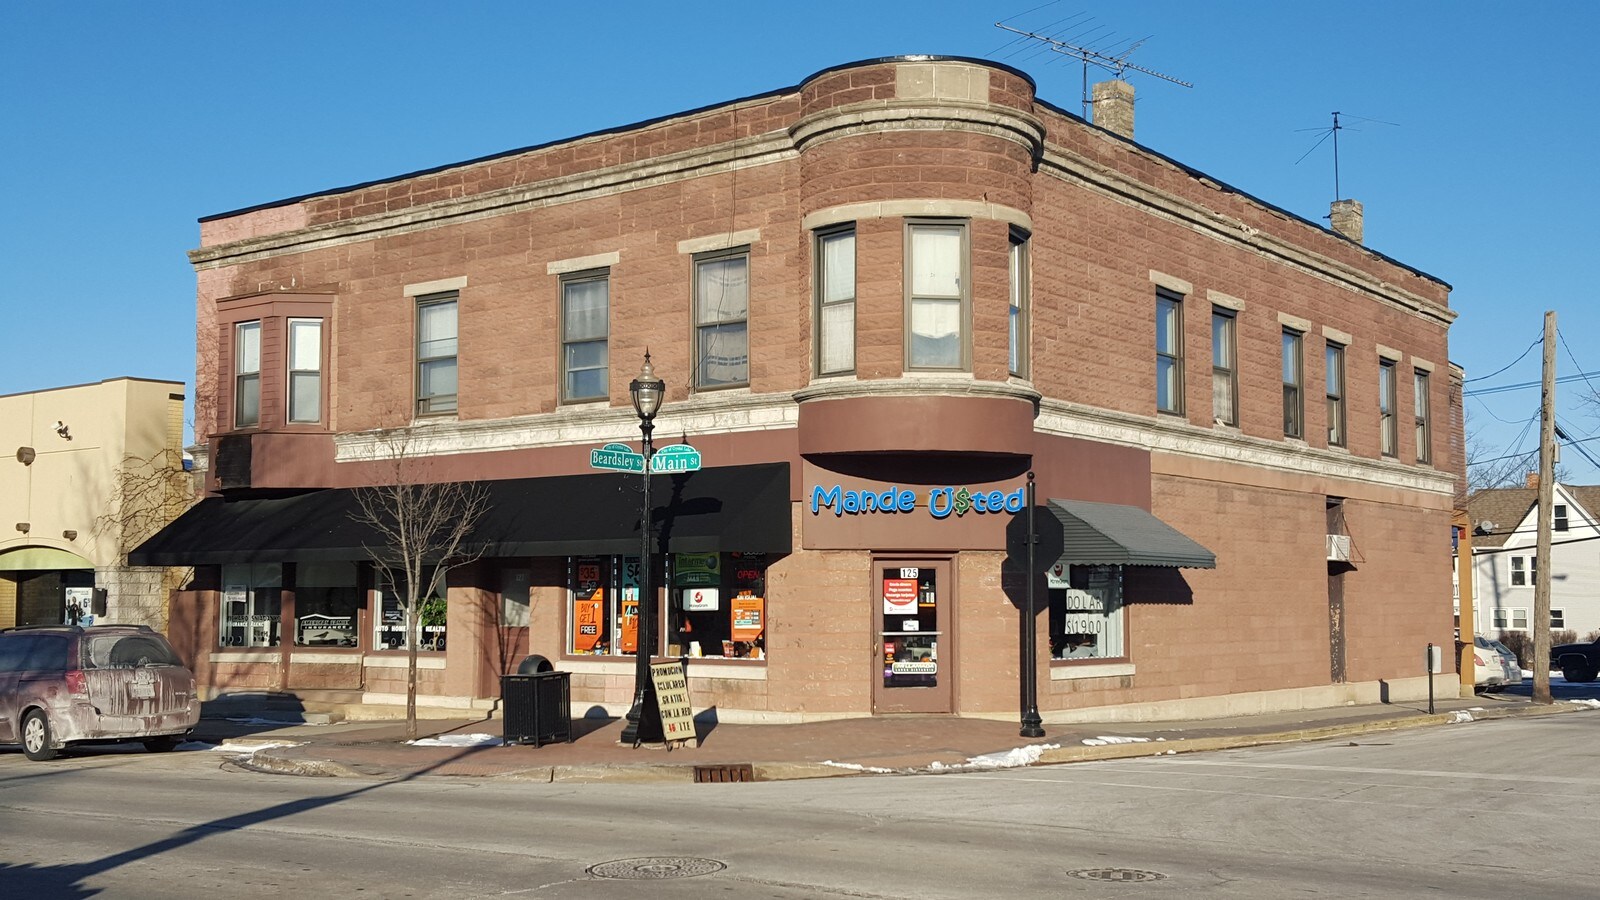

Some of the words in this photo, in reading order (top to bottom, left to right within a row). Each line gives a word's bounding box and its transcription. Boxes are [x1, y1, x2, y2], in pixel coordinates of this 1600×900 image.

[593, 452, 634, 469] Beardsley
[655, 454, 687, 470] Main
[690, 458, 697, 466] St
[811, 484, 915, 515] Mande
[738, 570, 760, 578] OPEN
[902, 569, 917, 578] 125
[1068, 596, 1102, 609] DOLAR
[580, 626, 596, 634] FREE
[652, 667, 682, 676] PROMOCION
[662, 710, 672, 718] CON
[674, 708, 680, 718] LA
[682, 708, 692, 716] RED
[680, 722, 690, 731] LTE
